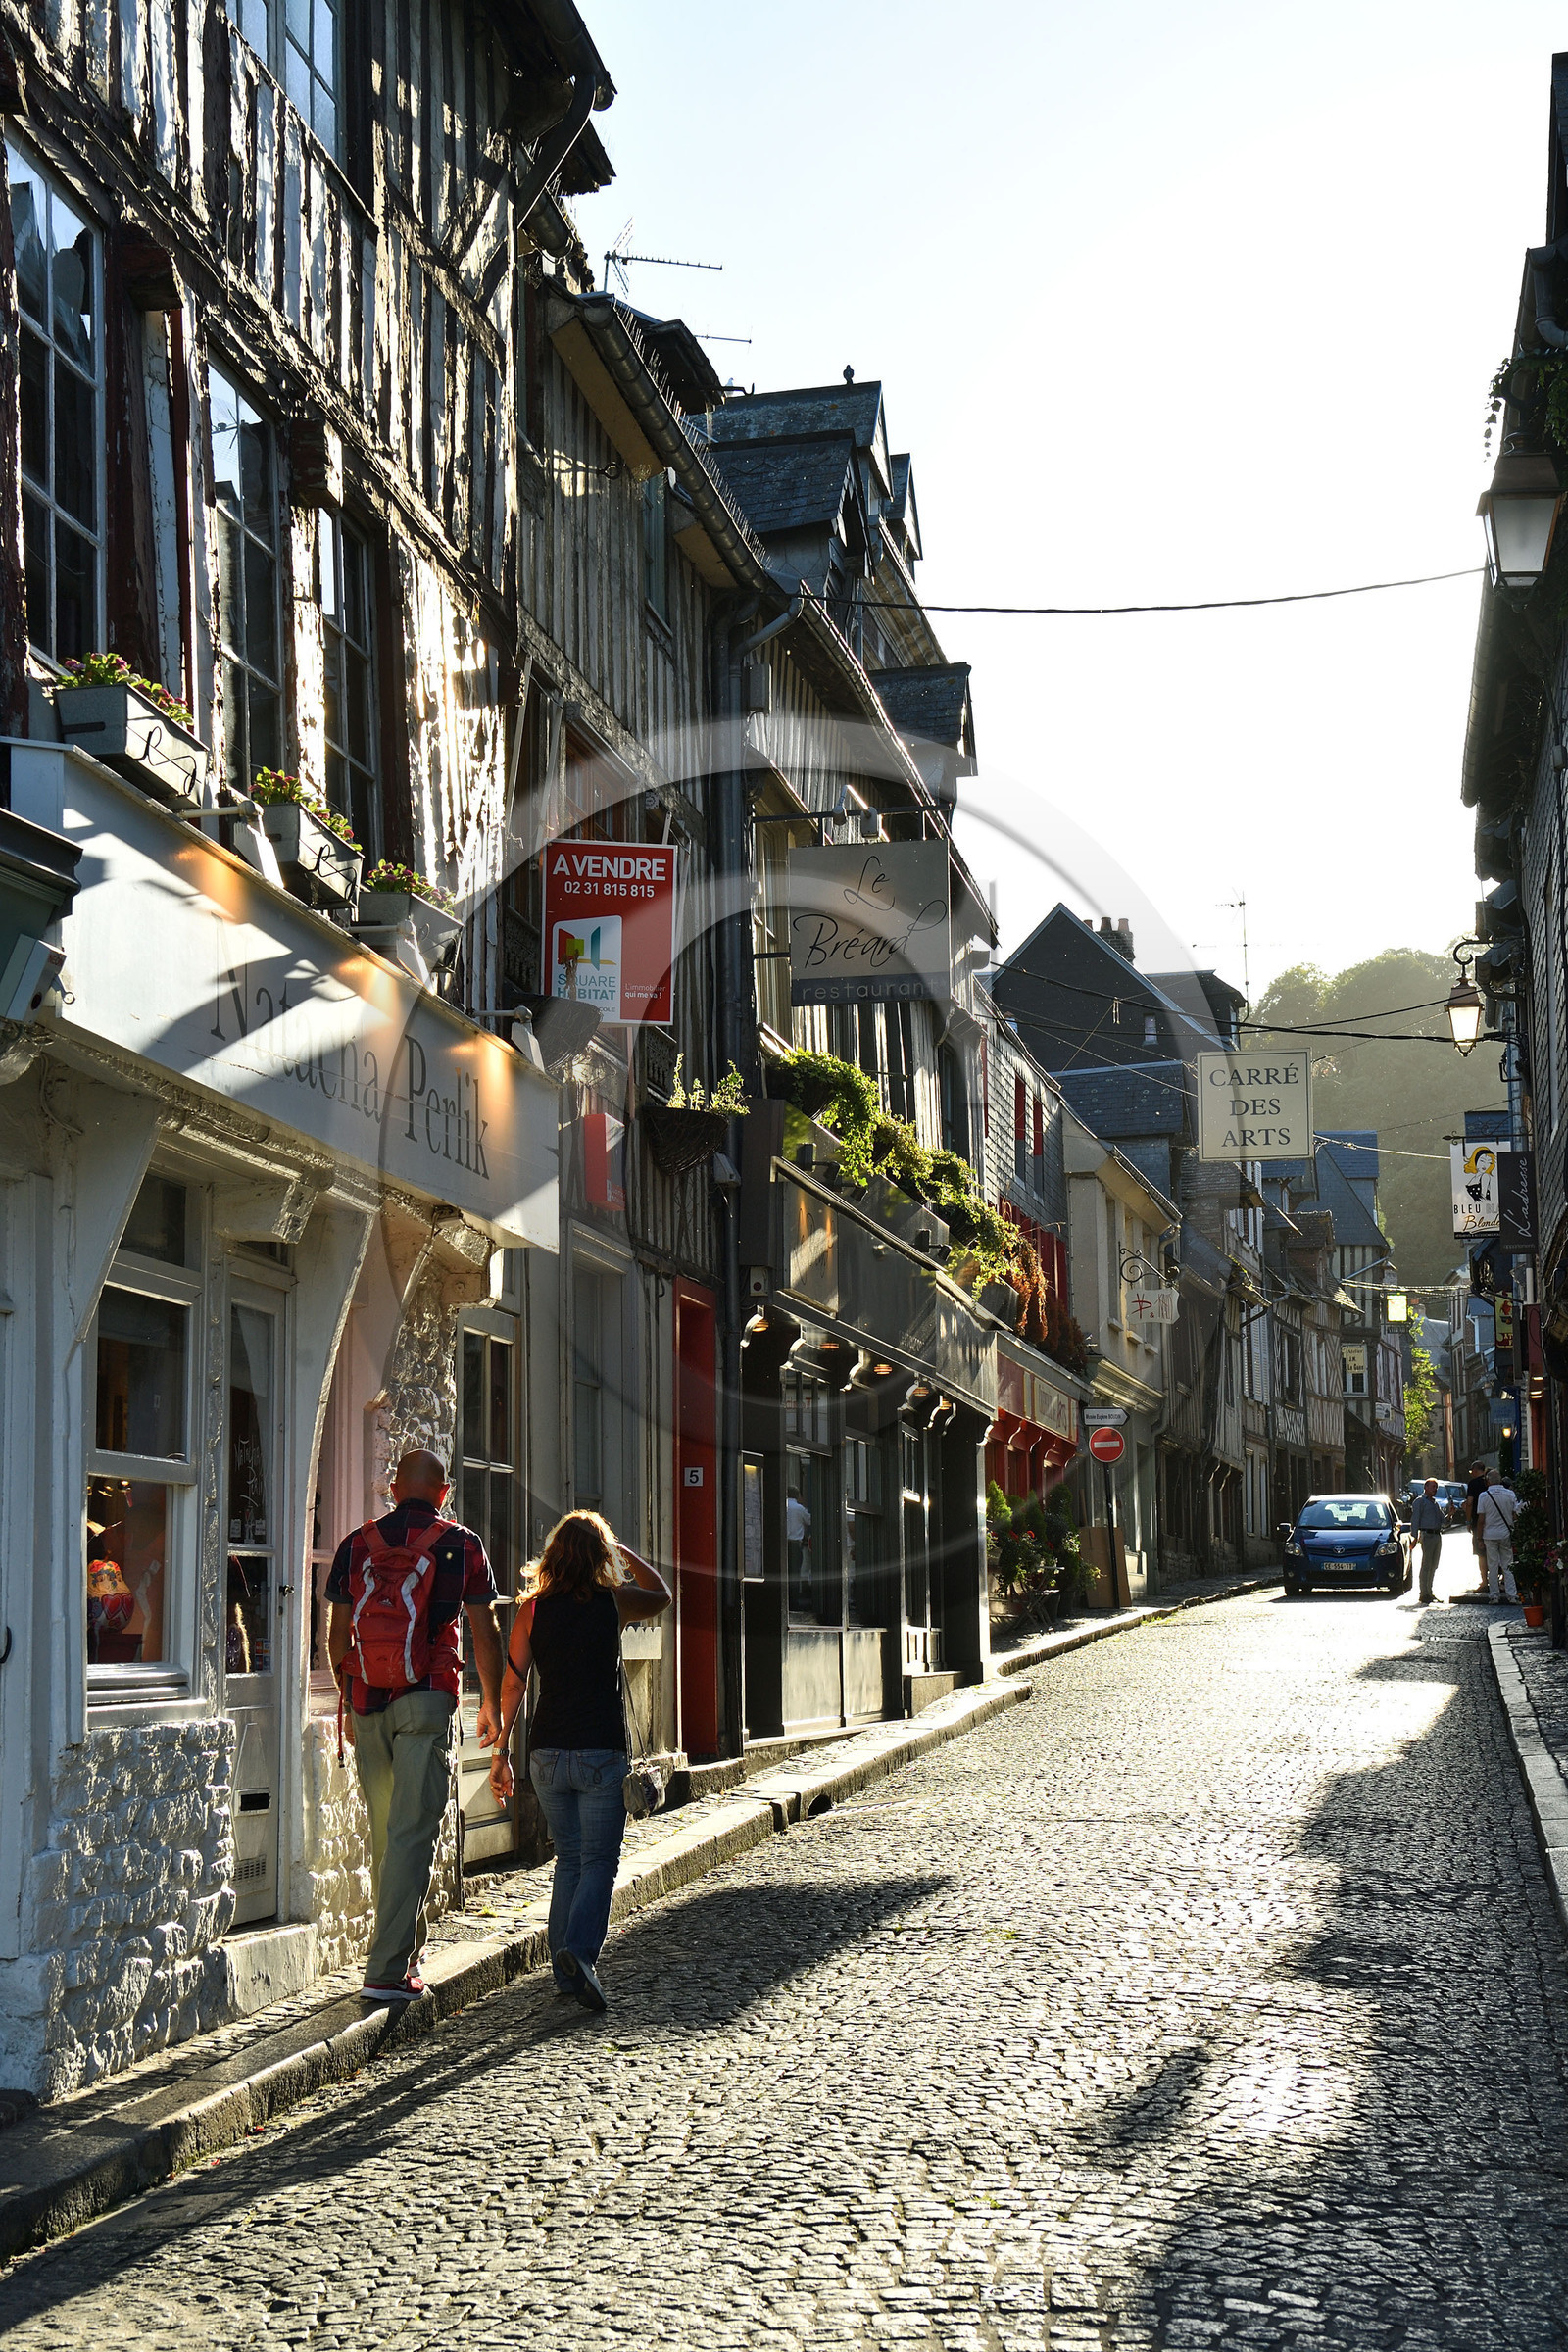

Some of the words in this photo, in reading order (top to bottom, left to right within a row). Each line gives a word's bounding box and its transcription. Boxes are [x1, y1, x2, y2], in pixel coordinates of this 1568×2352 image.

[552, 853, 570, 876] A
[572, 855, 666, 881] VENDRE
[564, 880, 581, 894] 02
[584, 881, 599, 895] 31
[603, 882, 627, 897] 815
[630, 883, 655, 898] 815
[843, 855, 896, 911] Le
[792, 899, 948, 968] Bréard
[557, 987, 616, 1001] HBITAT
[802, 979, 939, 1001] restaurant
[211, 912, 384, 1124] Natacha
[403, 1034, 490, 1181] Perlik
[1209, 1062, 1299, 1087] CARRÉ
[1229, 1098, 1282, 1117] DES
[1221, 1128, 1292, 1148] ARTS
[1453, 1203, 1482, 1215] BLEU
[689, 1469, 699, 1485] 5
